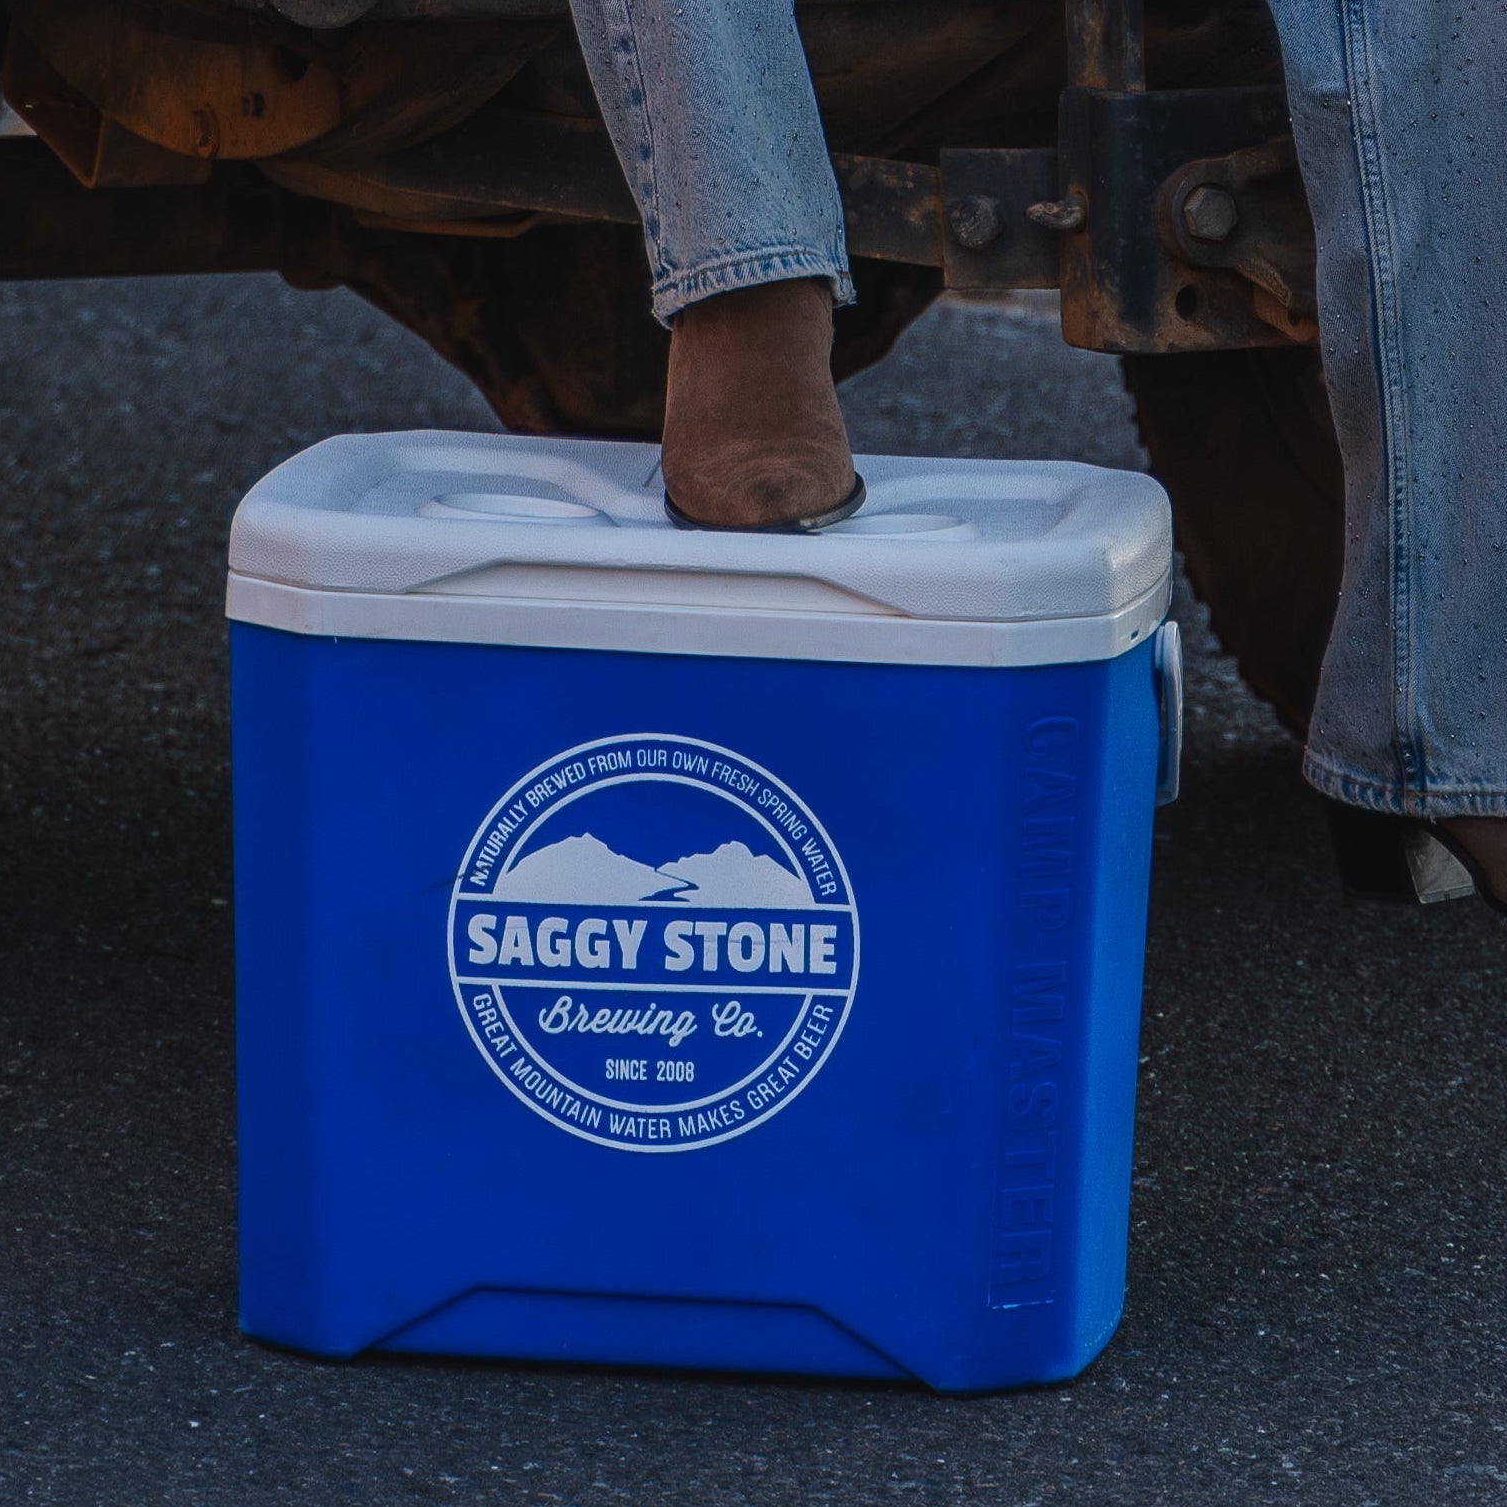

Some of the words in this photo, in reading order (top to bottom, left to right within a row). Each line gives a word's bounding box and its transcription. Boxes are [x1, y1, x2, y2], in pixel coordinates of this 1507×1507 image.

[469, 798, 529, 887] NATURALLY
[525, 761, 587, 808] BREWED
[587, 749, 632, 776] FROM
[636, 748, 668, 768] OUR
[672, 750, 710, 775] OWN
[710, 761, 760, 797] FRESH
[757, 788, 808, 841] SPRING
[801, 836, 837, 897] WATER
[1020, 715, 1079, 931] CAMP
[467, 913, 649, 970] SAGGY
[663, 919, 838, 975] STONE
[472, 992, 518, 1058] GREAT
[509, 1056, 603, 1129] MOUNTAIN
[609, 1112, 672, 1140] WATER
[677, 1099, 746, 1138] MAKES
[746, 1055, 800, 1110] GREAT
[792, 1004, 834, 1061] BEER
[538, 995, 698, 1048] Brewing
[711, 1000, 764, 1038] Co.
[605, 1058, 648, 1081] SINCE
[656, 1059, 695, 1083] 2008
[999, 961, 1068, 1284] MASTER
